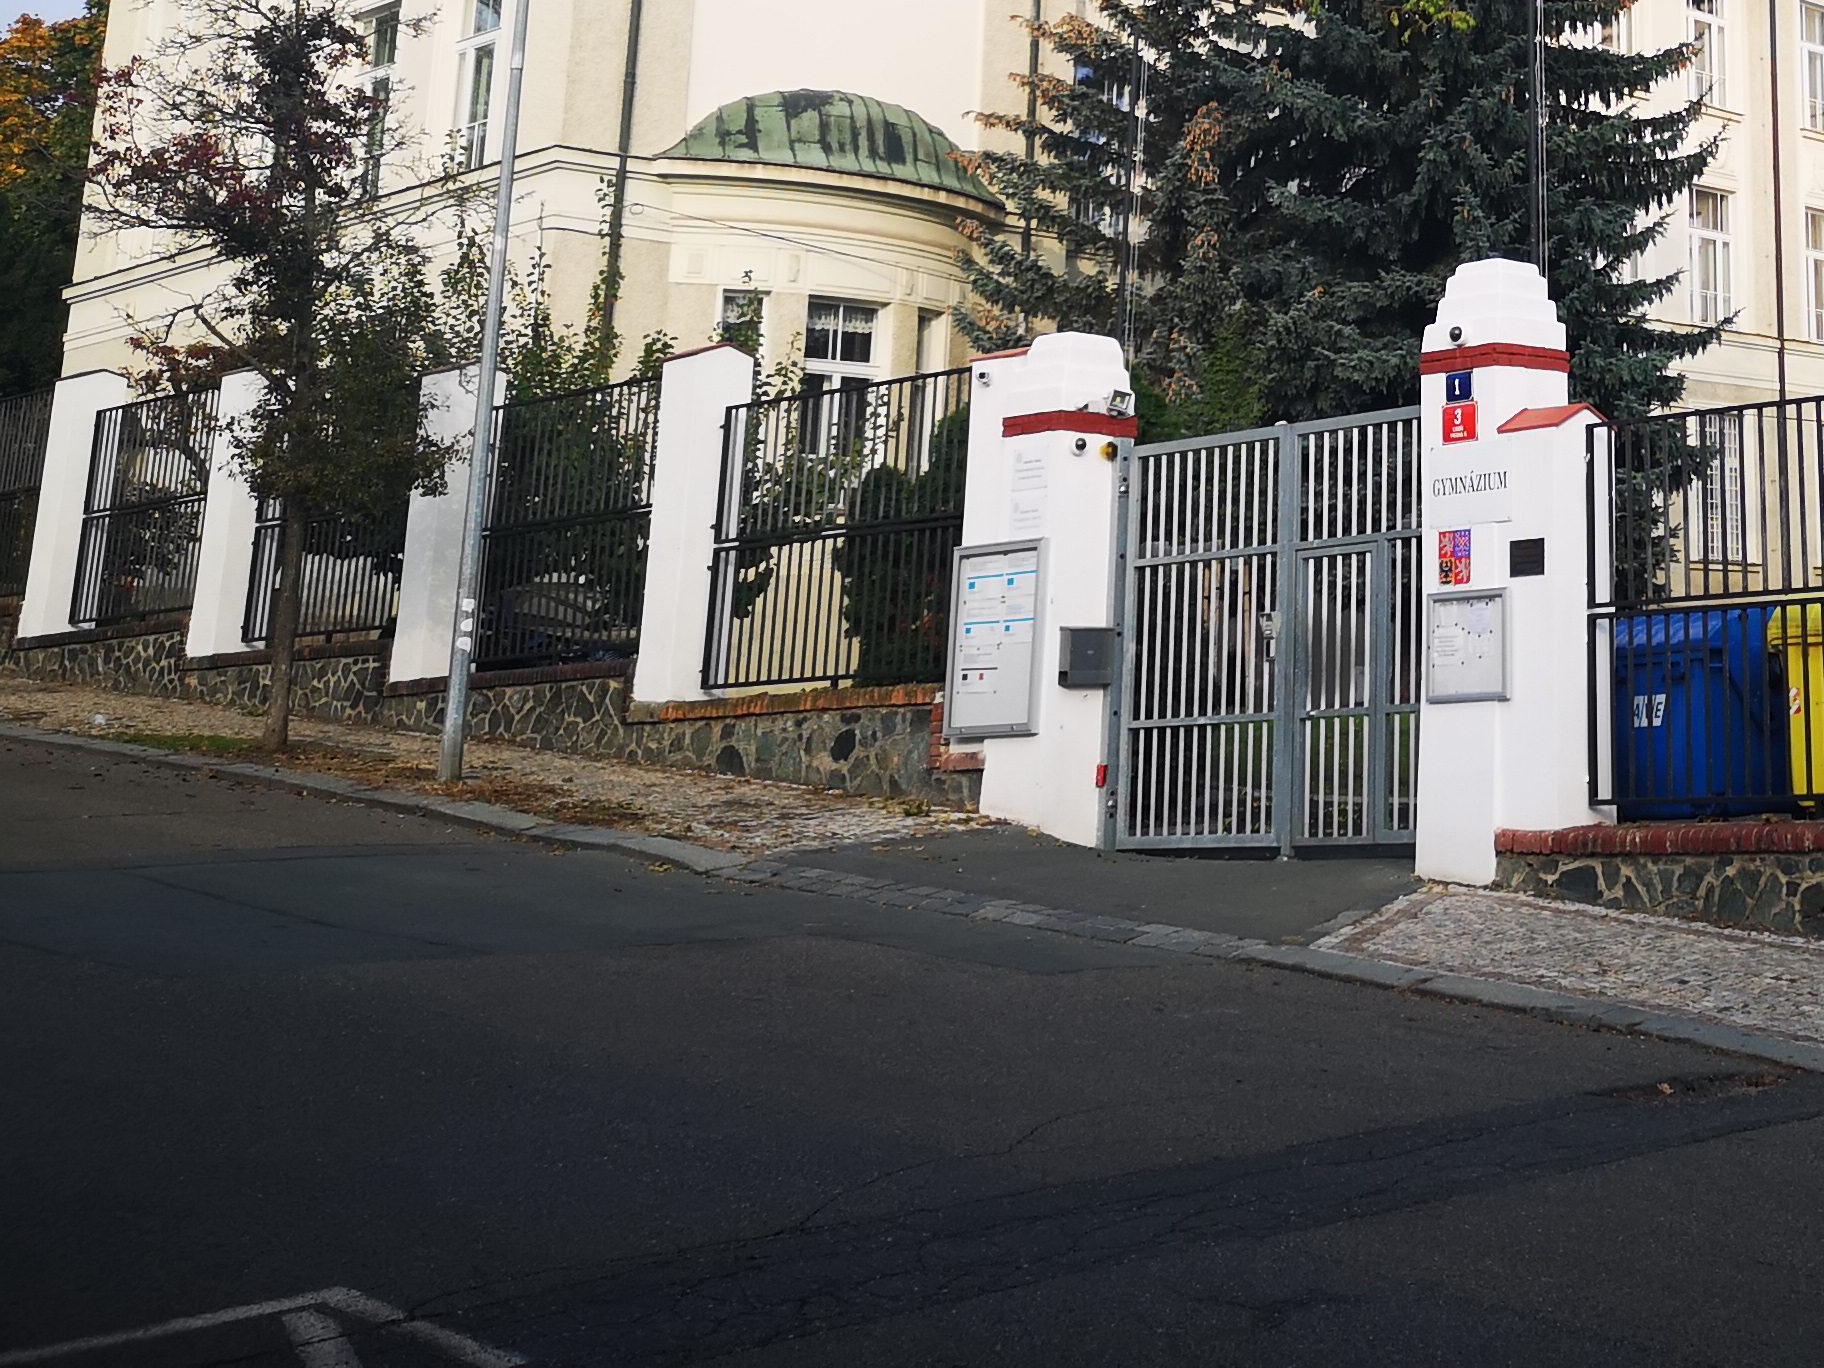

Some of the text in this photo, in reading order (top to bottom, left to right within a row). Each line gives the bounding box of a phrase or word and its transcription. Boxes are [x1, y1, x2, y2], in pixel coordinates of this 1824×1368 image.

[1454, 378, 1460, 395] 1
[1454, 408, 1462, 425] 3
[1432, 470, 1508, 498] GYMNÁZIUM
